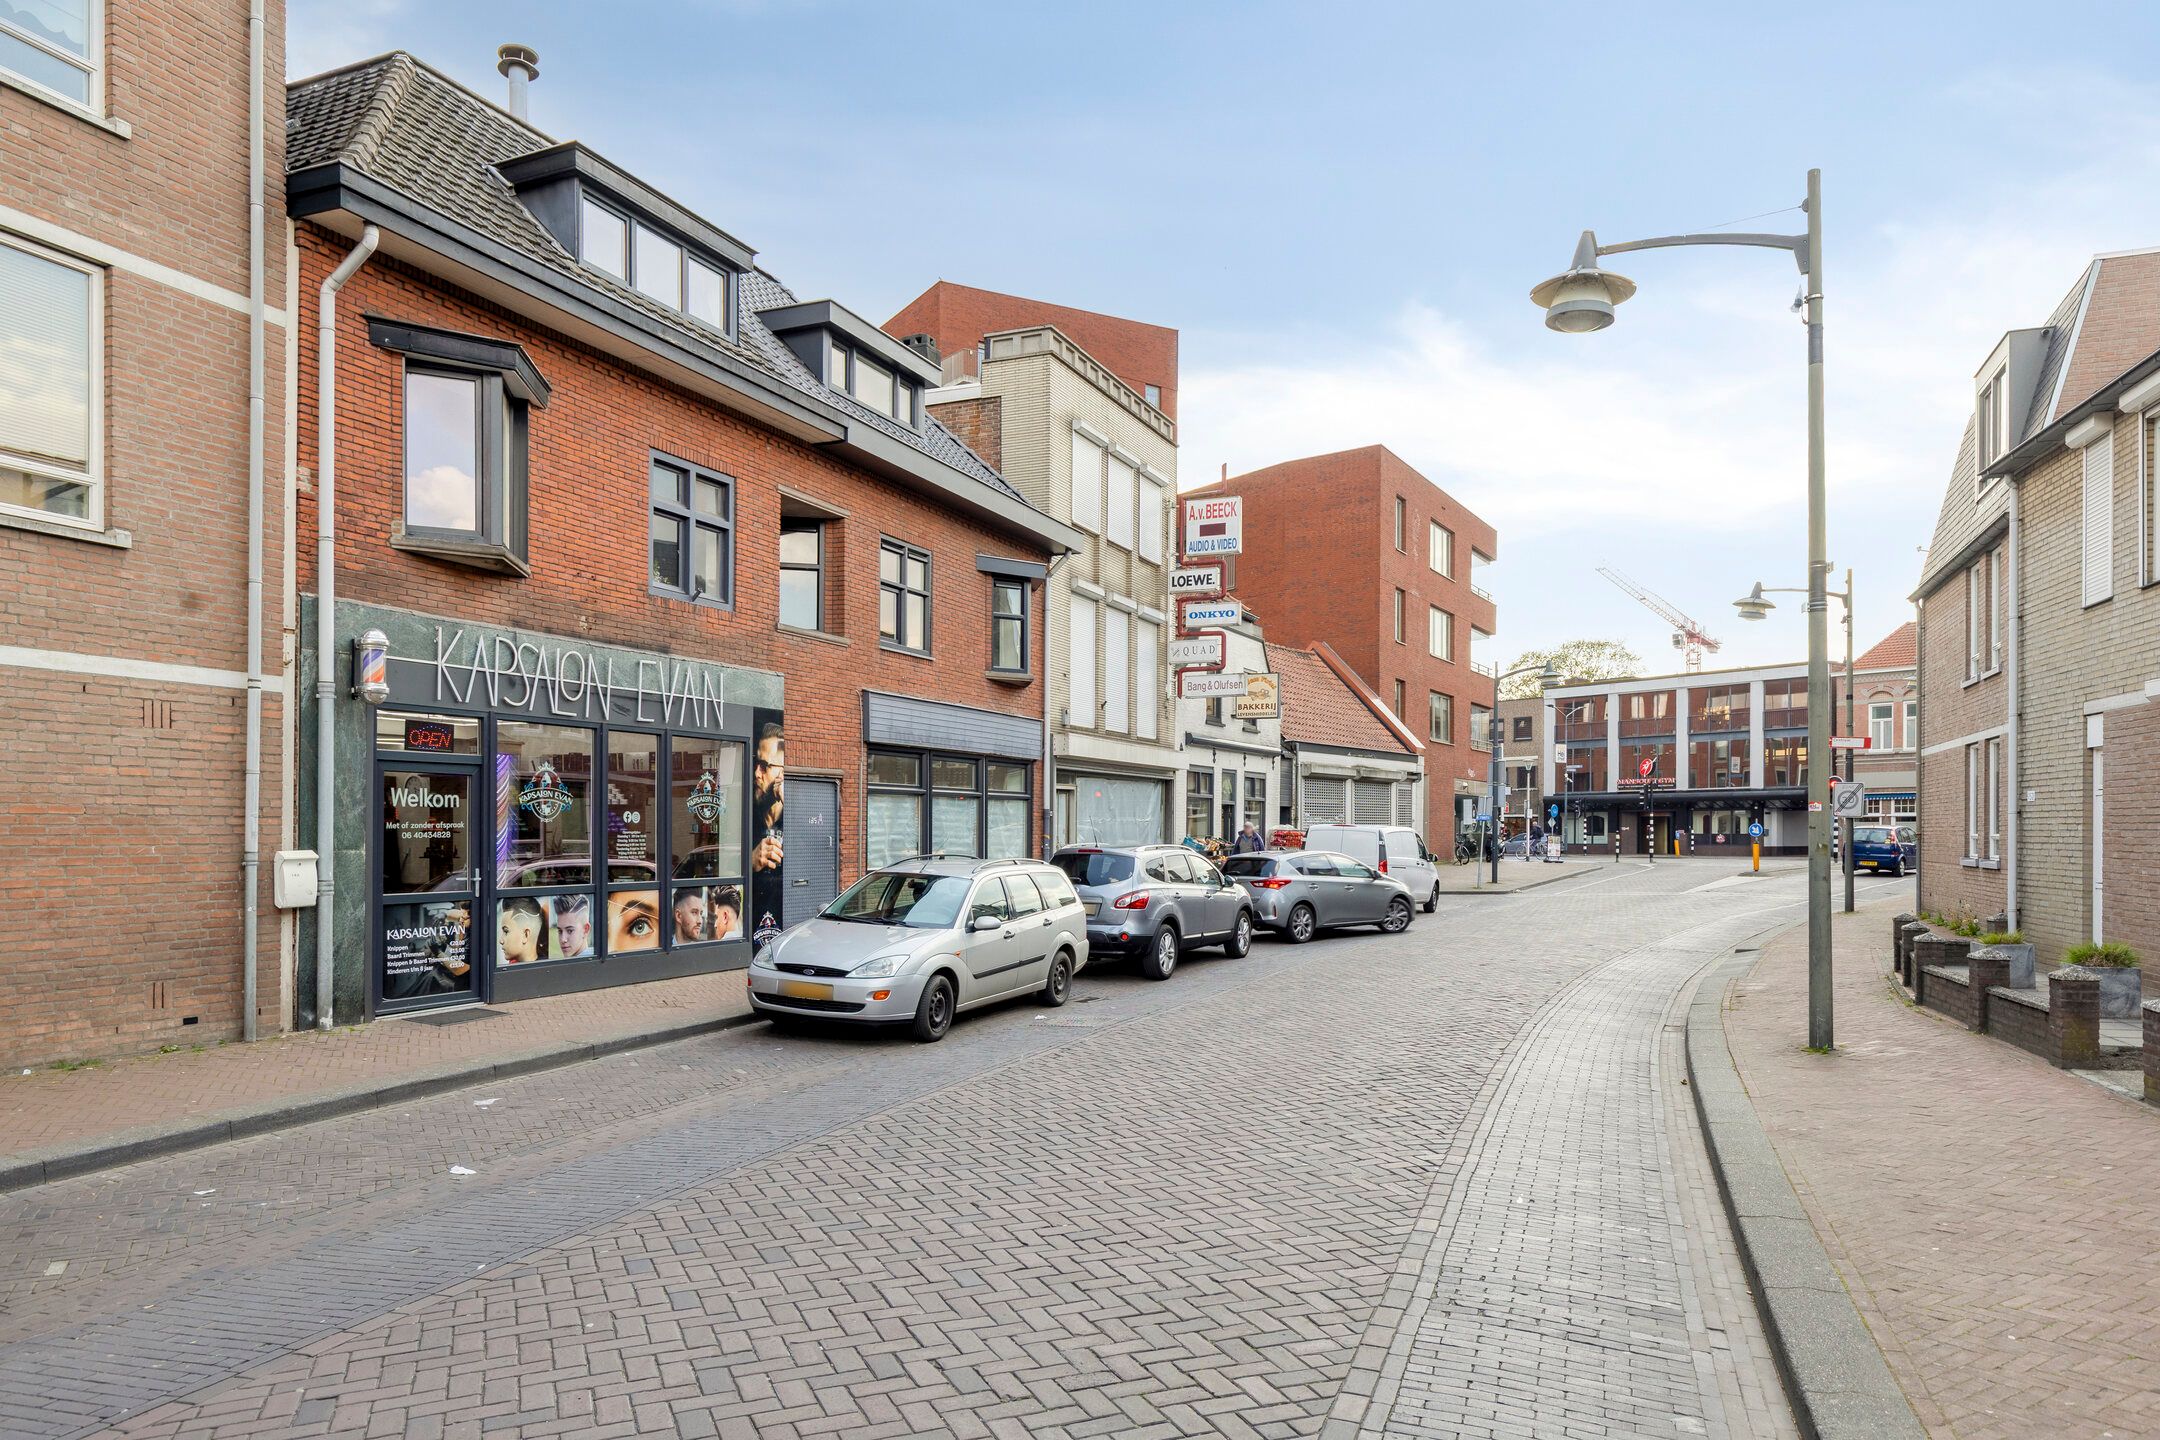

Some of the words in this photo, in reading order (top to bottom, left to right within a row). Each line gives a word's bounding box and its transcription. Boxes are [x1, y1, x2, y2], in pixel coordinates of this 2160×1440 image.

[1189, 501, 1237, 521] A.v.BEECK
[1188, 540, 1209, 552] AUDIO
[1210, 539, 1216, 551] &
[1217, 537, 1238, 550] VIDEO
[1171, 573, 1215, 588] LOEWE.
[1188, 609, 1236, 620] ONKYO
[1182, 644, 1216, 657] QUAD
[433, 625, 613, 721] KAPSALON
[636, 658, 725, 730] EVAN
[1187, 681, 1207, 692] Bang
[1207, 680, 1213, 691] &
[1213, 679, 1244, 690] Olufsen
[1237, 702, 1277, 711] BAKKERIJ
[409, 729, 451, 748] OPEN
[391, 787, 460, 808] Welkom
[519, 790, 553, 804] KAPSALON
[435, 820, 465, 830] afspraak
[386, 926, 437, 941] KAPSALON
[439, 924, 466, 936] EVAN
[387, 967, 410, 975] Kinderen
